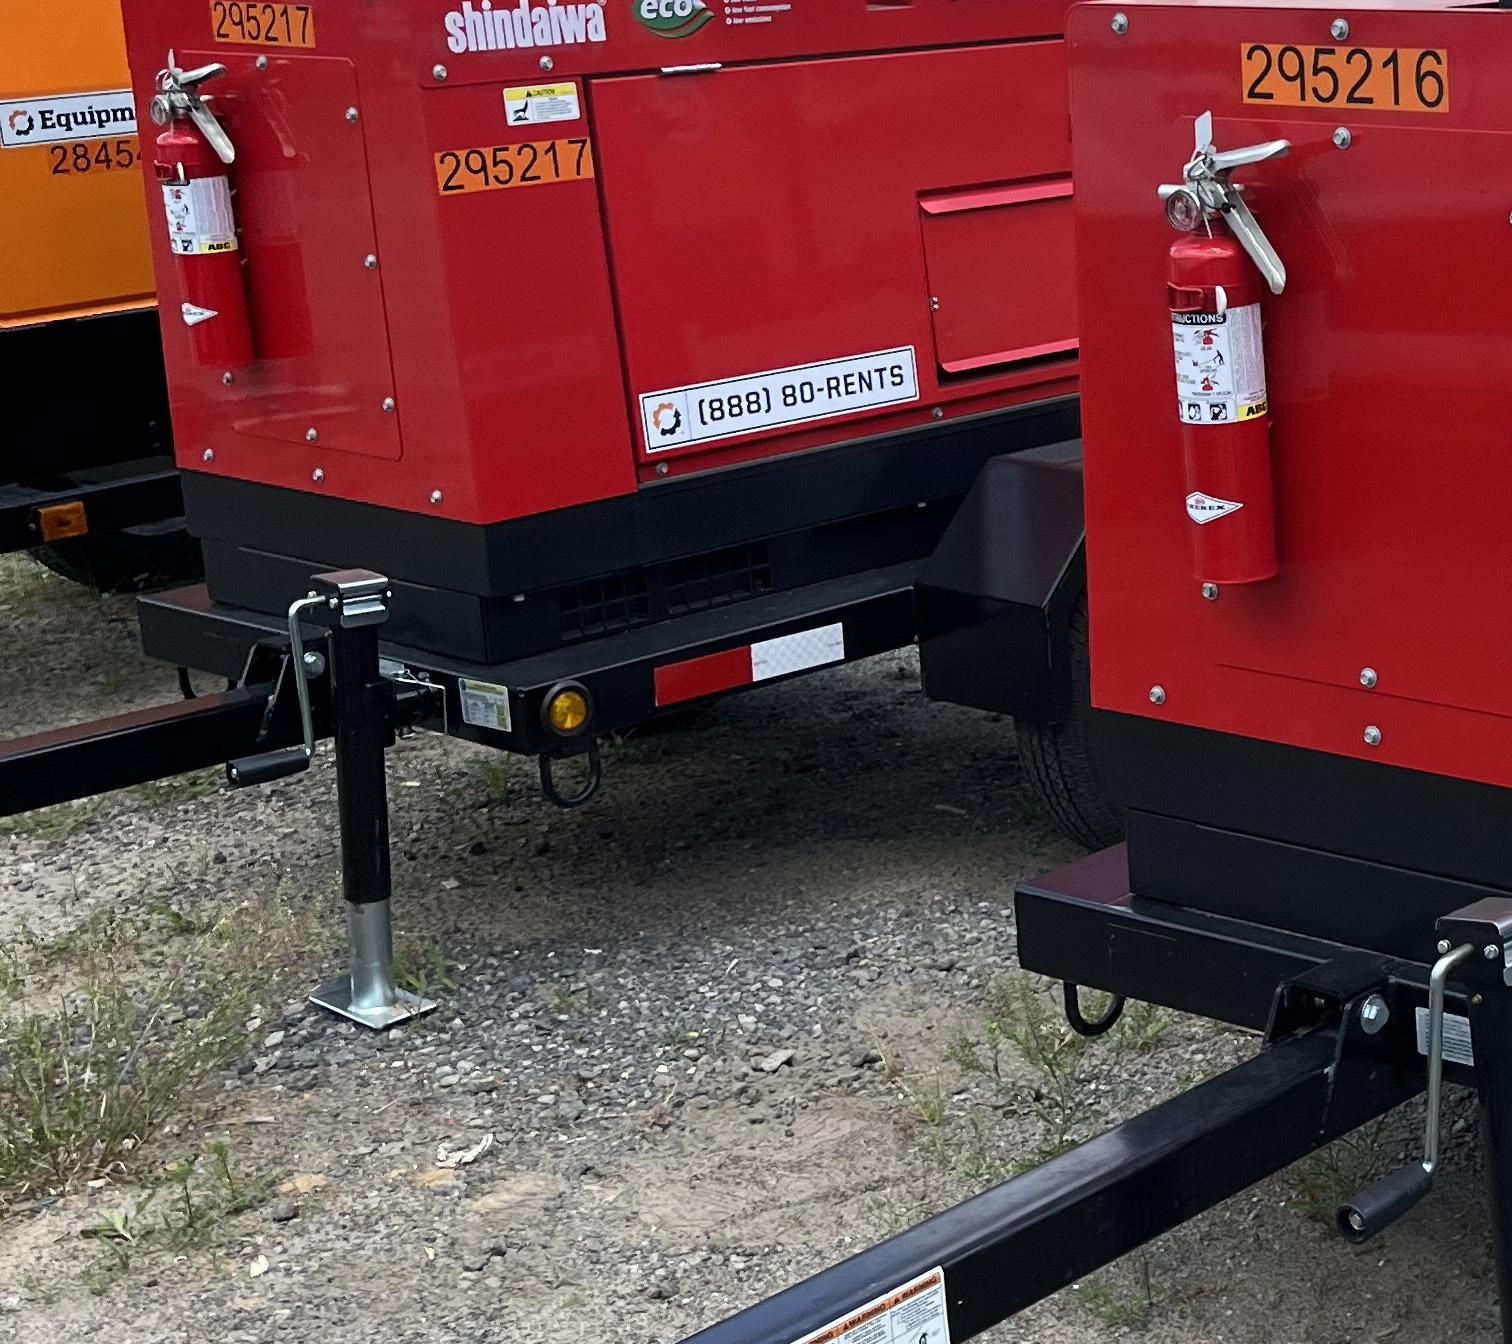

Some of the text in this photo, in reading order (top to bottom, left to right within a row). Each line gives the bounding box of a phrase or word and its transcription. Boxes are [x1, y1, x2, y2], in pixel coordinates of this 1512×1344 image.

[213, 1, 312, 44] 295217
[1246, 44, 1444, 108] 295216
[50, 140, 141, 175] 2845
[439, 138, 588, 192] 295217
[208, 242, 230, 251] ABC
[698, 364, 905, 426] (888) 80-RENTS
[850, 1303, 886, 1326] WARNING
